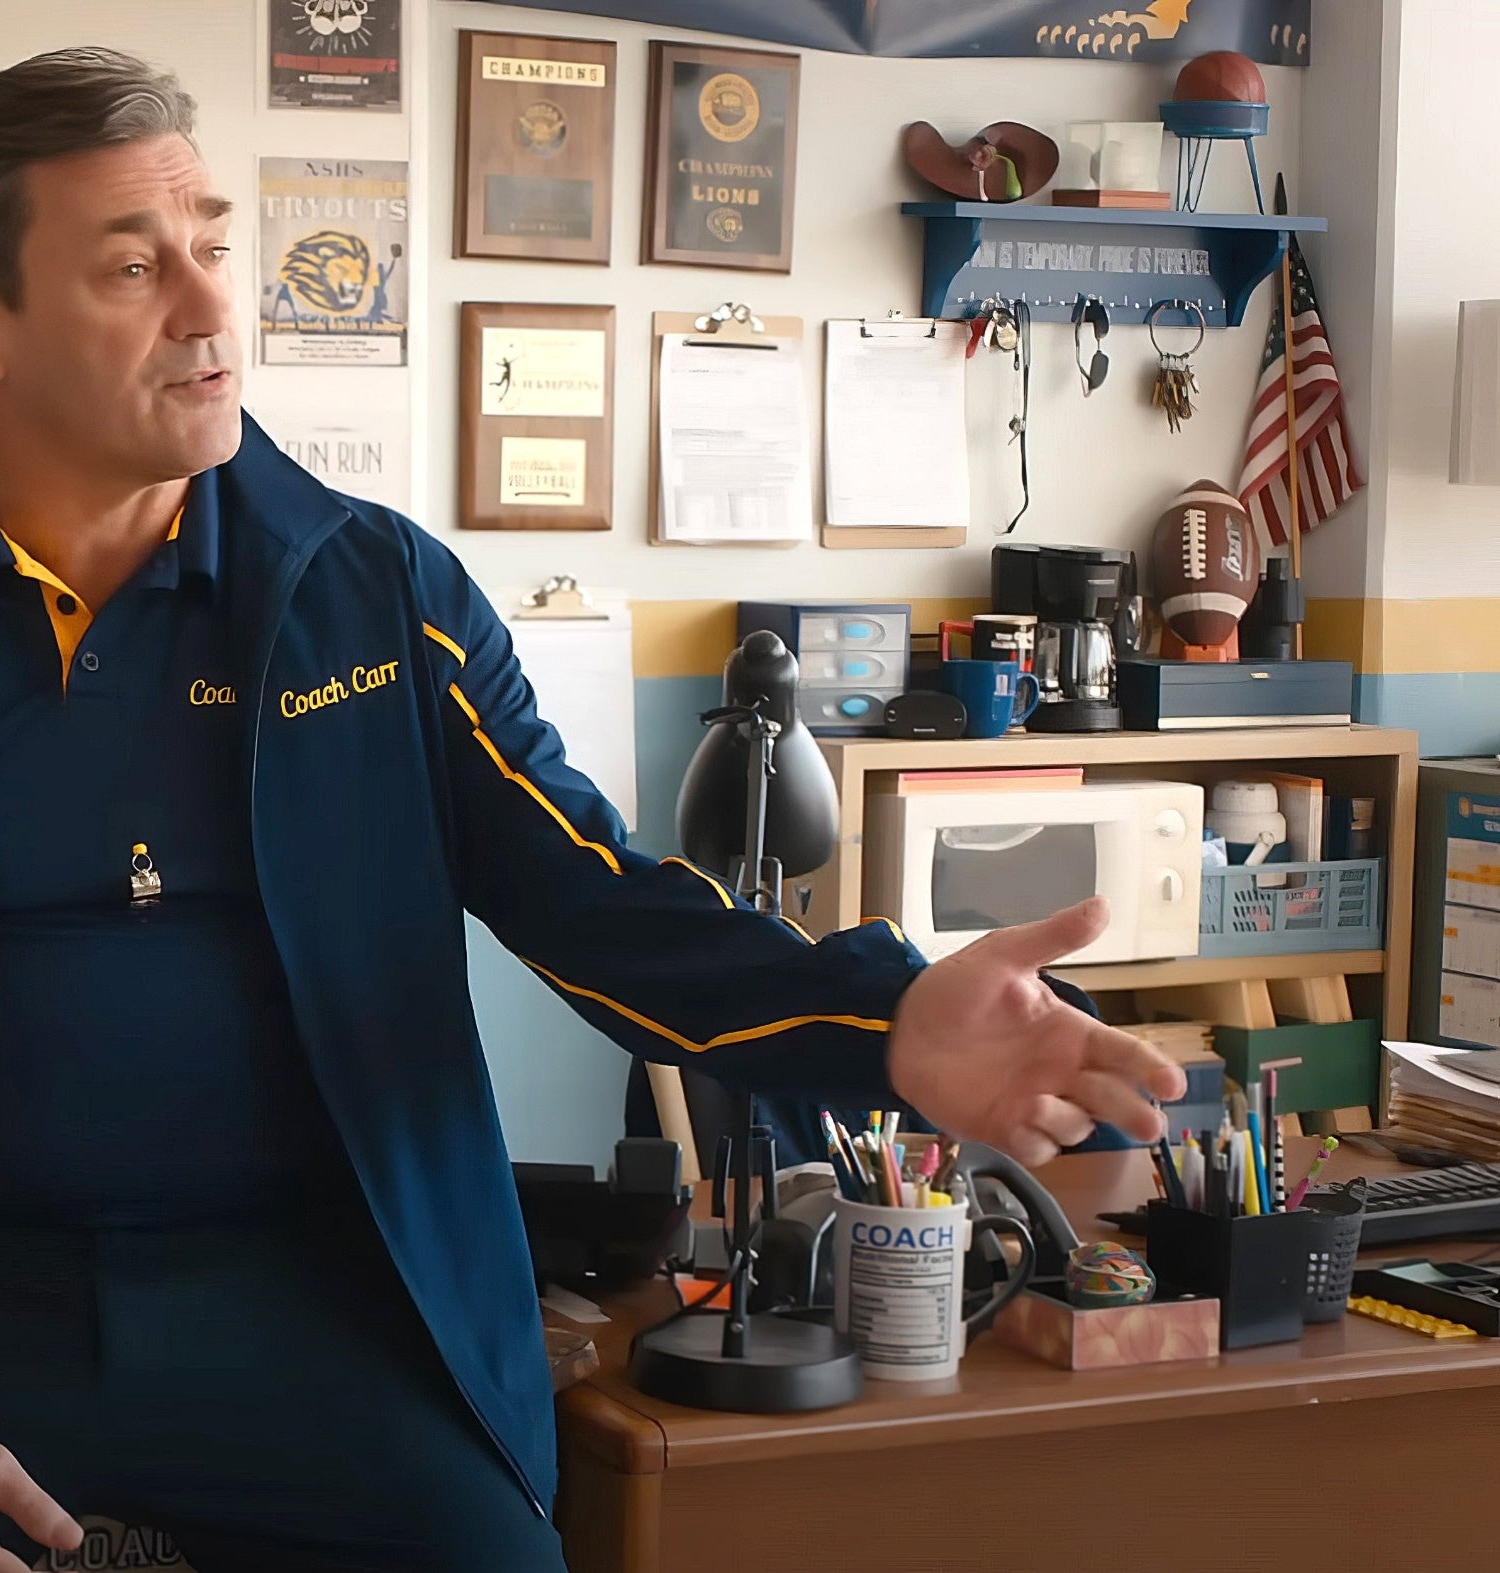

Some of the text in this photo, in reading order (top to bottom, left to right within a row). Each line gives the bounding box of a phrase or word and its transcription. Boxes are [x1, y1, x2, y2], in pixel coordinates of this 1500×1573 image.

[489, 61, 598, 82] CHAMPIONS
[692, 184, 760, 206] LIONS
[337, 440, 382, 474] RUN
[280, 661, 399, 718] Coach Carr
[852, 1222, 954, 1249] COACH
